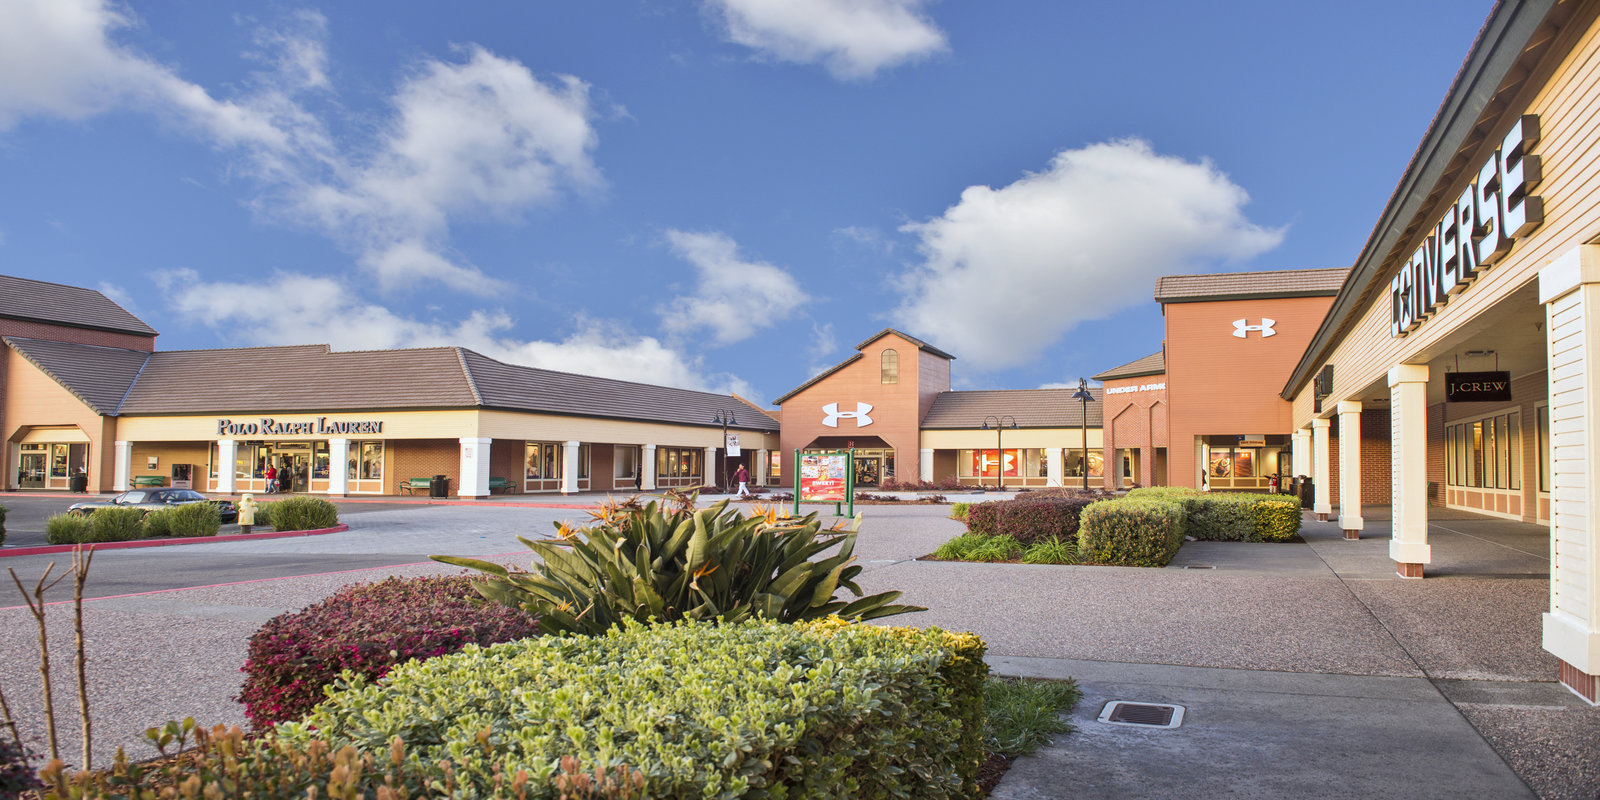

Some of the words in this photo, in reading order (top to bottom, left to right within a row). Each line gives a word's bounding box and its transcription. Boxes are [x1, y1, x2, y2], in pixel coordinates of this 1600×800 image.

[1390, 114, 1532, 339] CONVERSE
[1106, 386, 1138, 394] UNDER
[1450, 381, 1507, 396] J.CREW
[217, 418, 258, 435] POLO
[260, 418, 314, 435] RALPH
[316, 417, 383, 434] LAUREN
